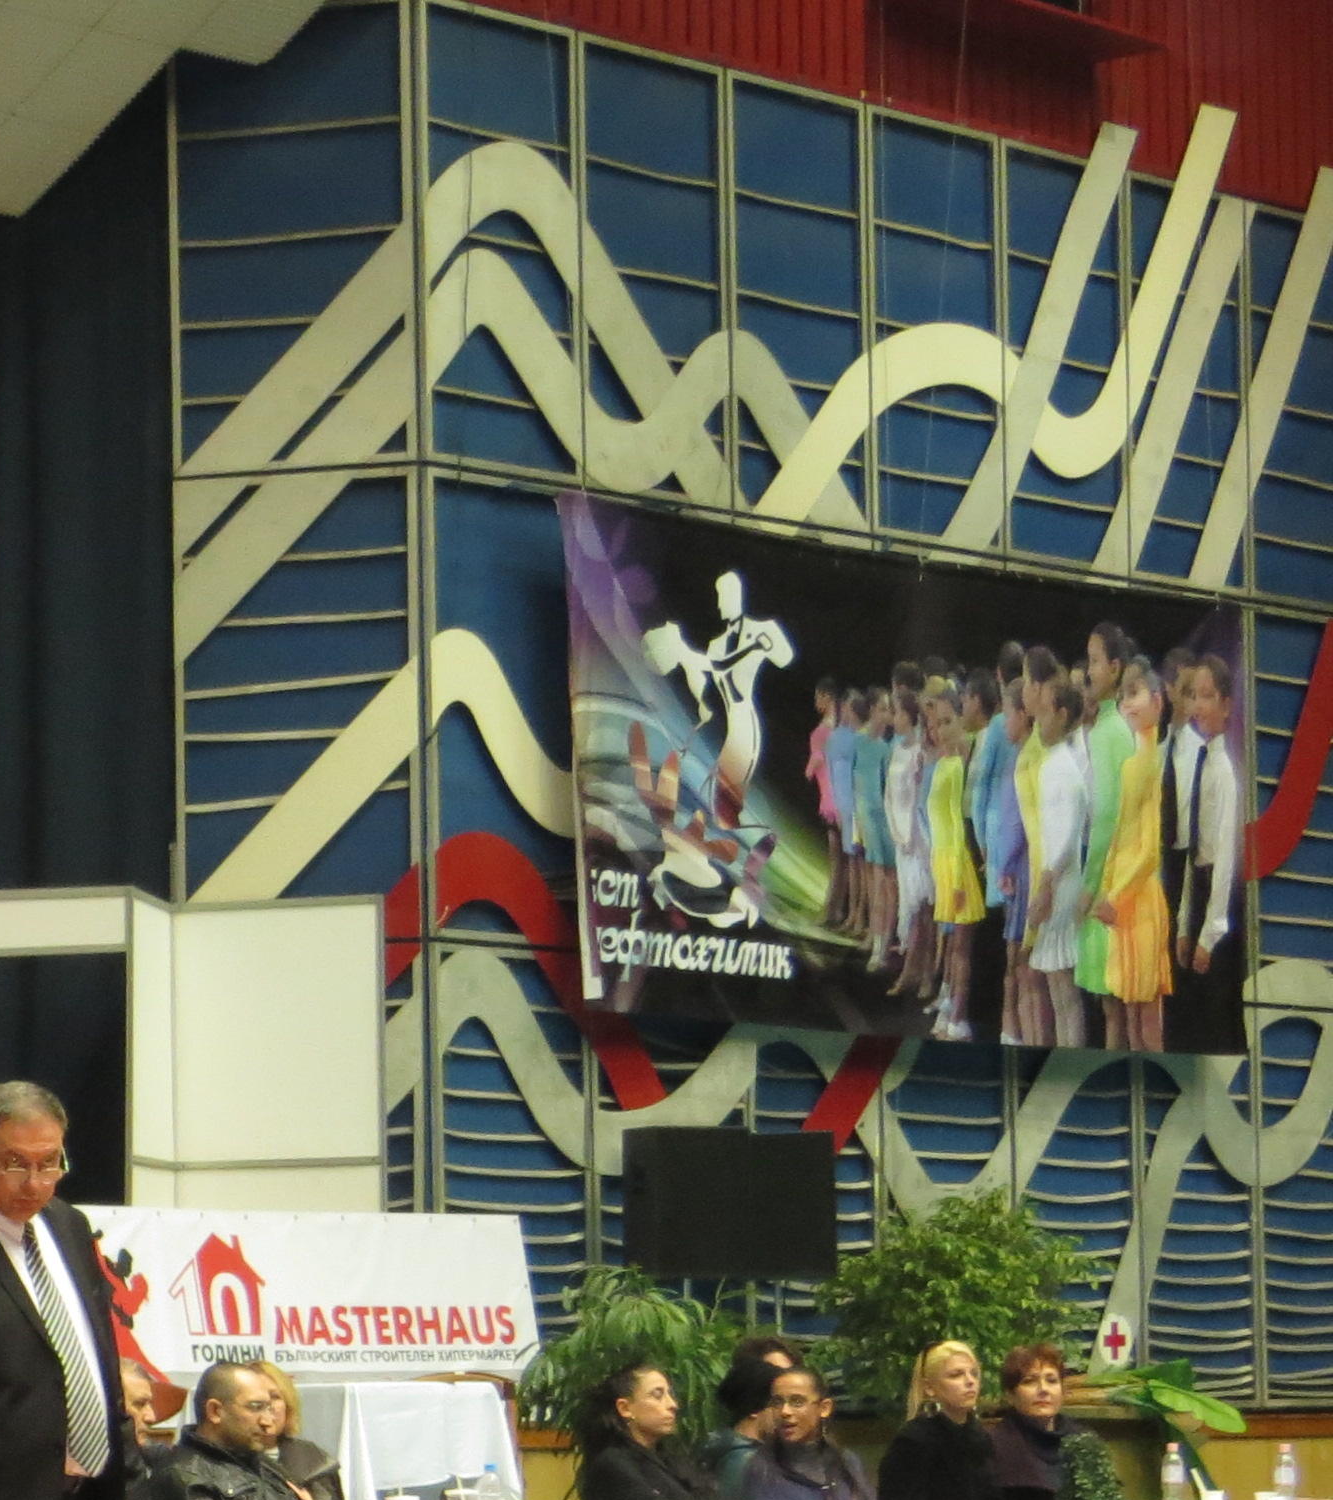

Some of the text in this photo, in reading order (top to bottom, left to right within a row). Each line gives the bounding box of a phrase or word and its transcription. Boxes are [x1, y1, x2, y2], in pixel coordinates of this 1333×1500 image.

[597, 909, 793, 982] ефтохимик
[274, 1304, 516, 1346] MASTERHAUS
[192, 1344, 265, 1363] ГОДИНИ
[361, 1349, 434, 1362] СТРОИТЕЛЕН
